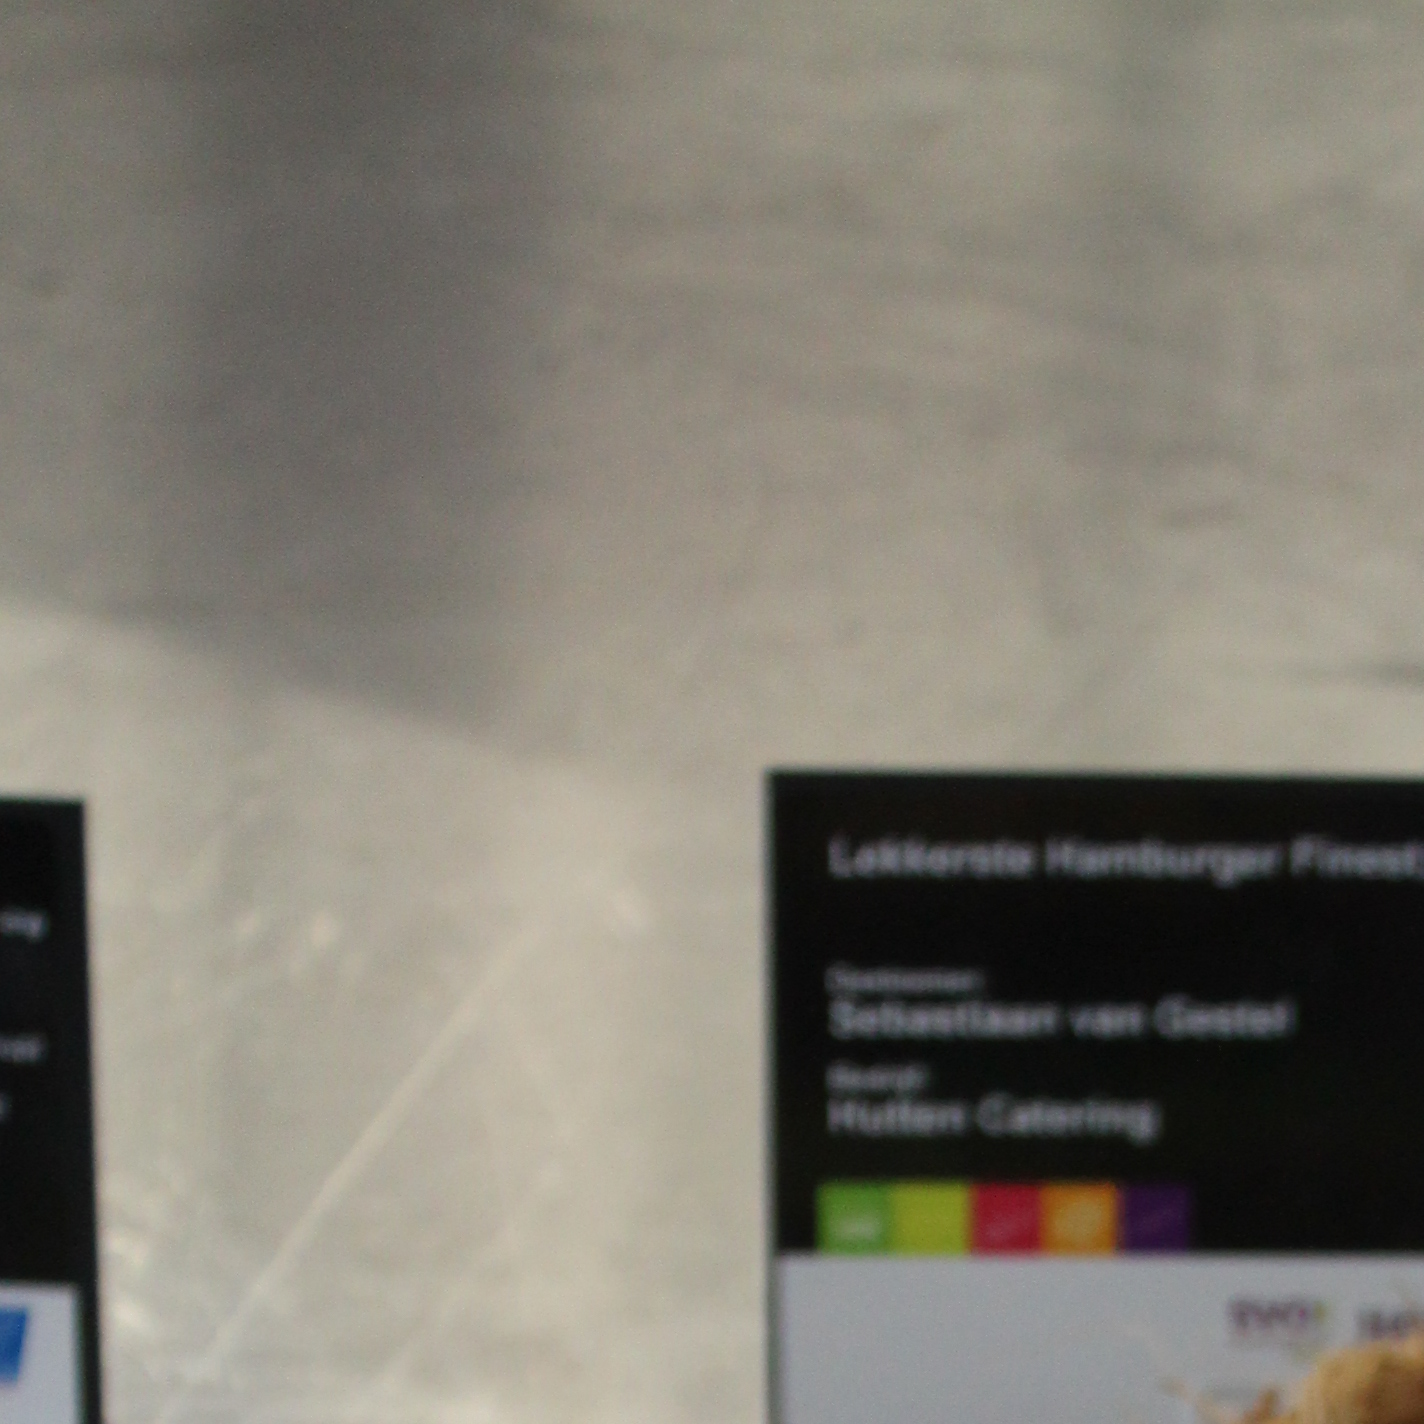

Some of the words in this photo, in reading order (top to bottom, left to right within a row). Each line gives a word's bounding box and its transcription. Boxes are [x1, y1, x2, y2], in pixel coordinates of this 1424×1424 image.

[1044, 837, 1281, 886] Hamburger
[1070, 1004, 1143, 1037] van
[977, 1094, 1160, 1145] Catering
